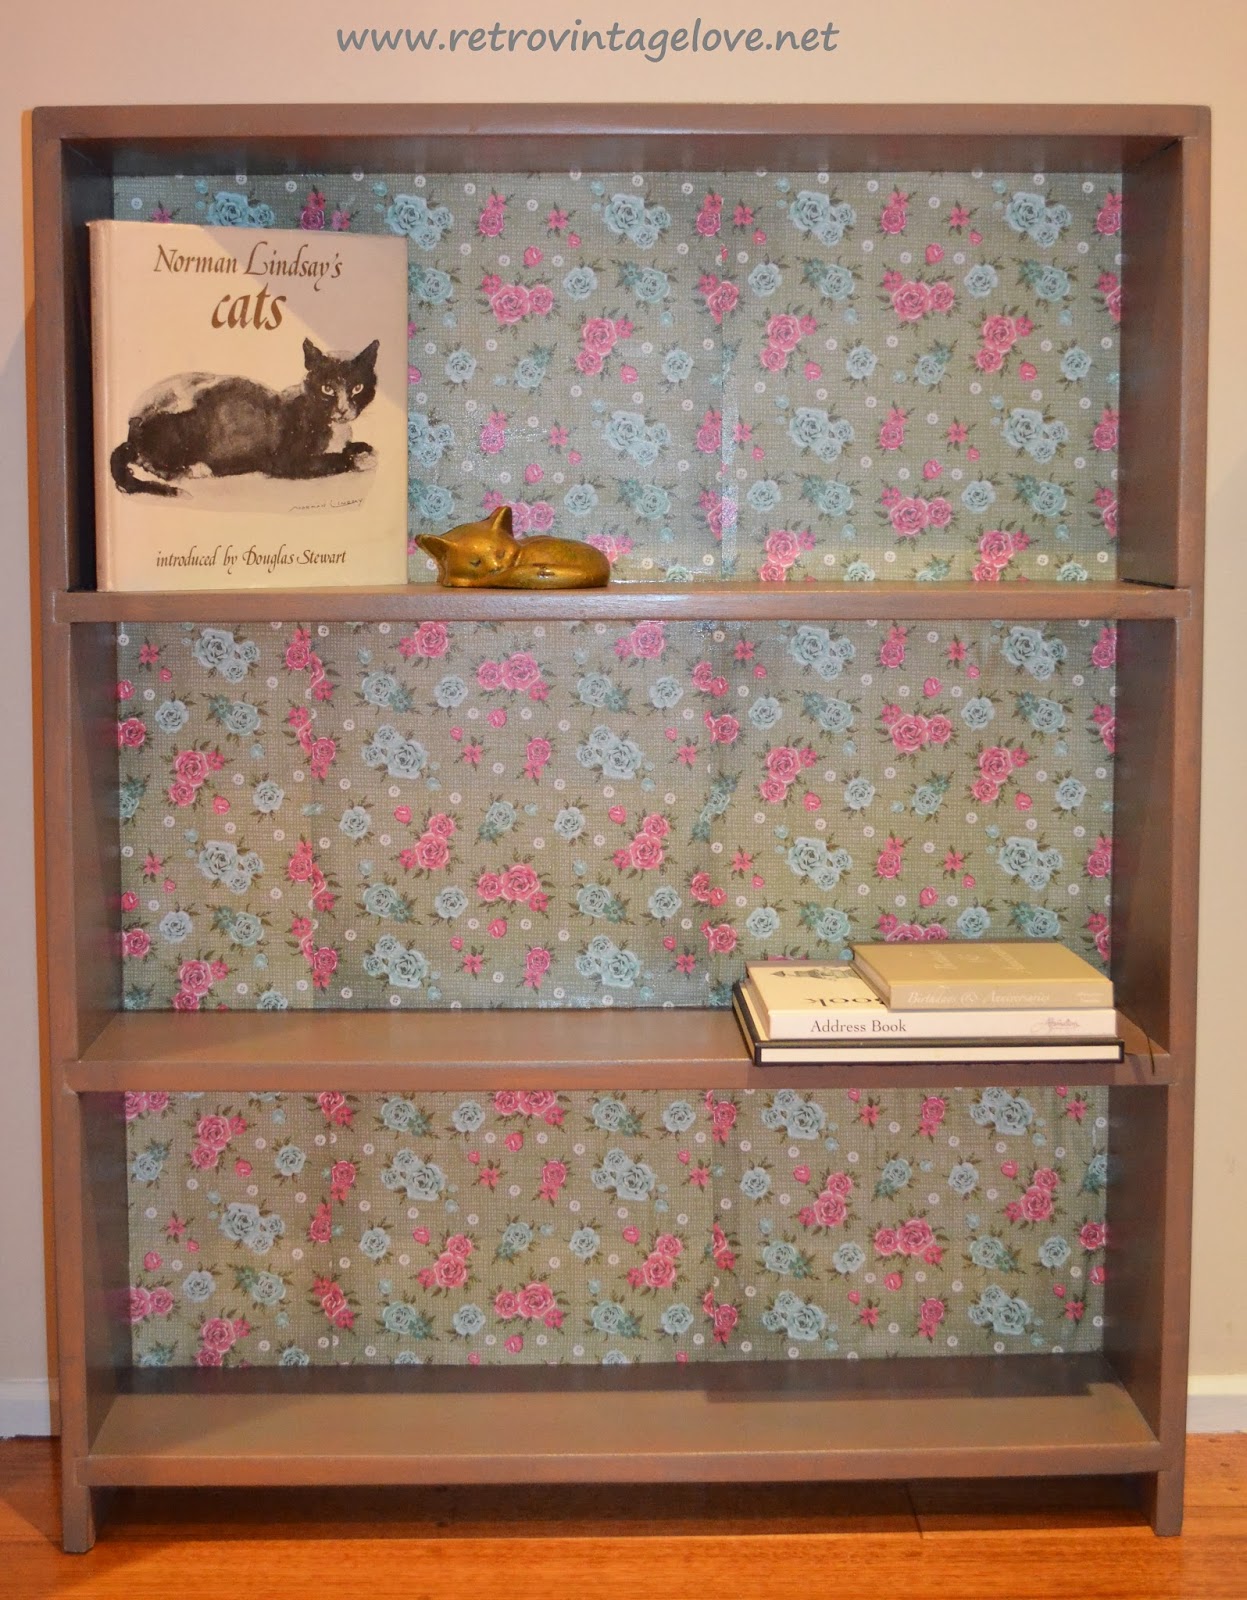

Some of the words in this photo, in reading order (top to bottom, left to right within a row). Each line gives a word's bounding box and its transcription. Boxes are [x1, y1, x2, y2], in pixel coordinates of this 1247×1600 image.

[153, 244, 237, 274] Norman
[242, 241, 343, 291] Lindsay's
[211, 282, 287, 330] cats
[156, 545, 221, 567] introduced
[223, 545, 238, 574] by
[242, 543, 294, 573] Douglas
[296, 549, 347, 566] Stewart
[810, 1019, 866, 1033] Address
[871, 1018, 907, 1032] Book
